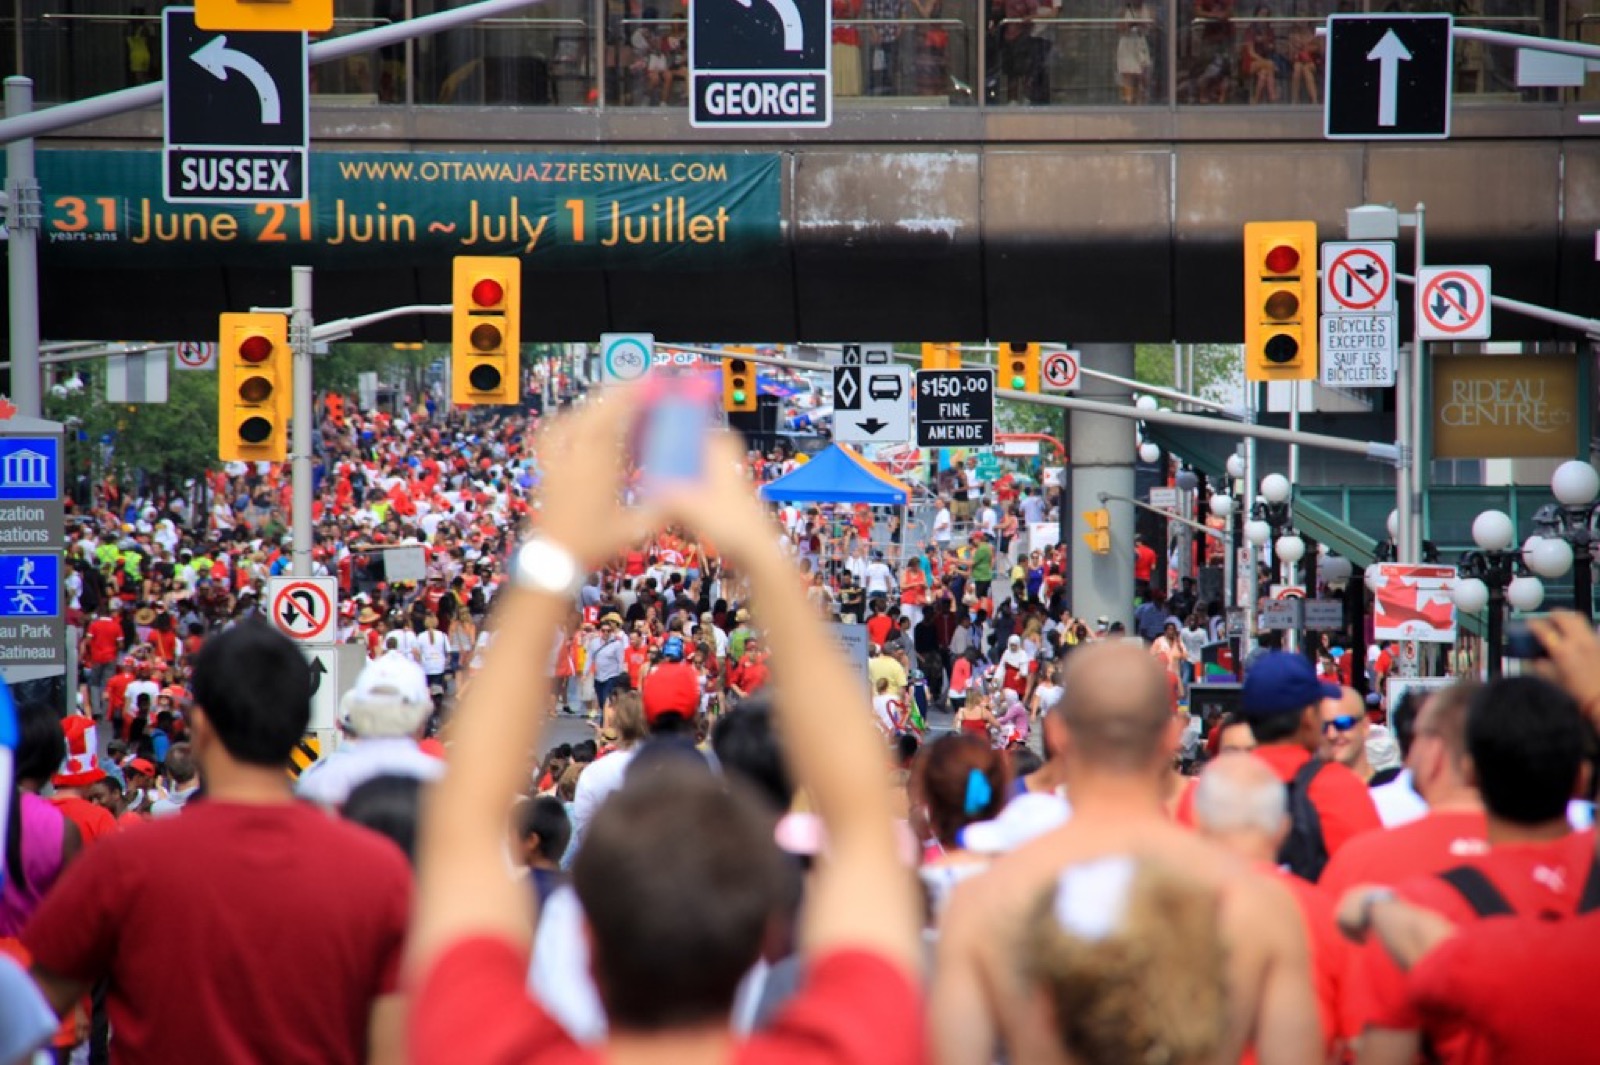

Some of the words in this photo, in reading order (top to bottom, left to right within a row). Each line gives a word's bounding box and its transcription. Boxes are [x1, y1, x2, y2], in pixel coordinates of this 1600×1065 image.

[705, 82, 816, 115] GEORGE
[181, 157, 290, 191] SUSSEX
[339, 161, 727, 182] WWW.OTTAWAJAZZFESTIVAL.COM
[52, 196, 117, 231] 31
[132, 198, 238, 244] June
[255, 201, 312, 241] 21
[327, 199, 416, 245] Juin
[460, 196, 548, 253] July
[565, 199, 585, 242] 1
[601, 196, 730, 246] Juillet
[1329, 319, 1386, 333] BICYCLES
[1329, 335, 1385, 348] EXCEPTED
[1334, 352, 1359, 366] SAUF
[1362, 352, 1381, 366] LES
[1328, 367, 1387, 381] BICYCLETTES
[1452, 378, 1545, 402] RIDEAU
[939, 402, 970, 417] FINE
[1441, 401, 1556, 432] CENTRE
[928, 425, 983, 440] AMENDE
[21, 624, 52, 638] Park
